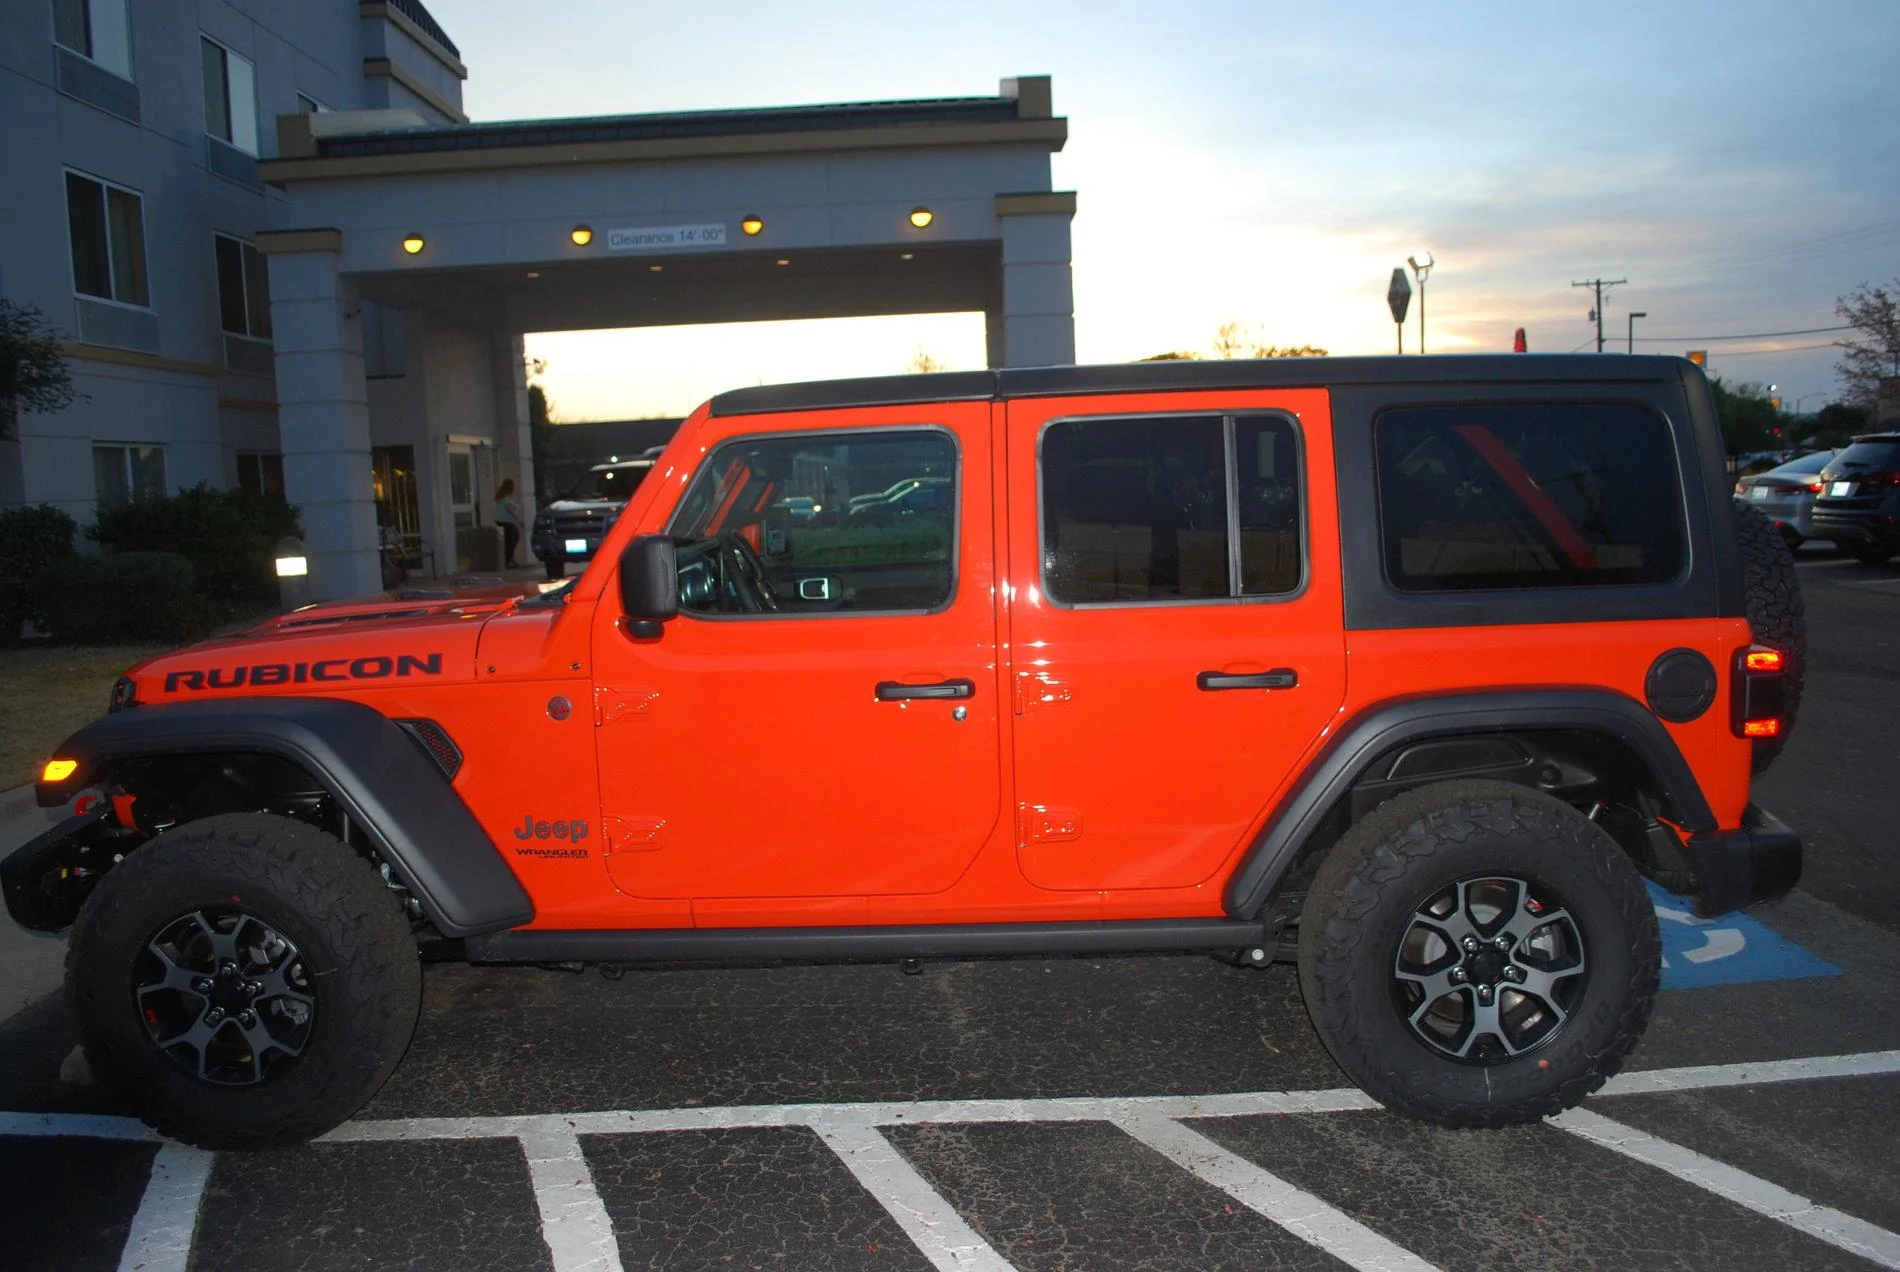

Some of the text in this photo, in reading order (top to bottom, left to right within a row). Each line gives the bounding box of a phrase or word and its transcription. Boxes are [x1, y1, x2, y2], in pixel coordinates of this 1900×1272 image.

[610, 231, 674, 246] Clearance
[164, 652, 443, 693] RUBICON
[514, 815, 588, 843] Jeep
[516, 848, 588, 856] WRANGLER
